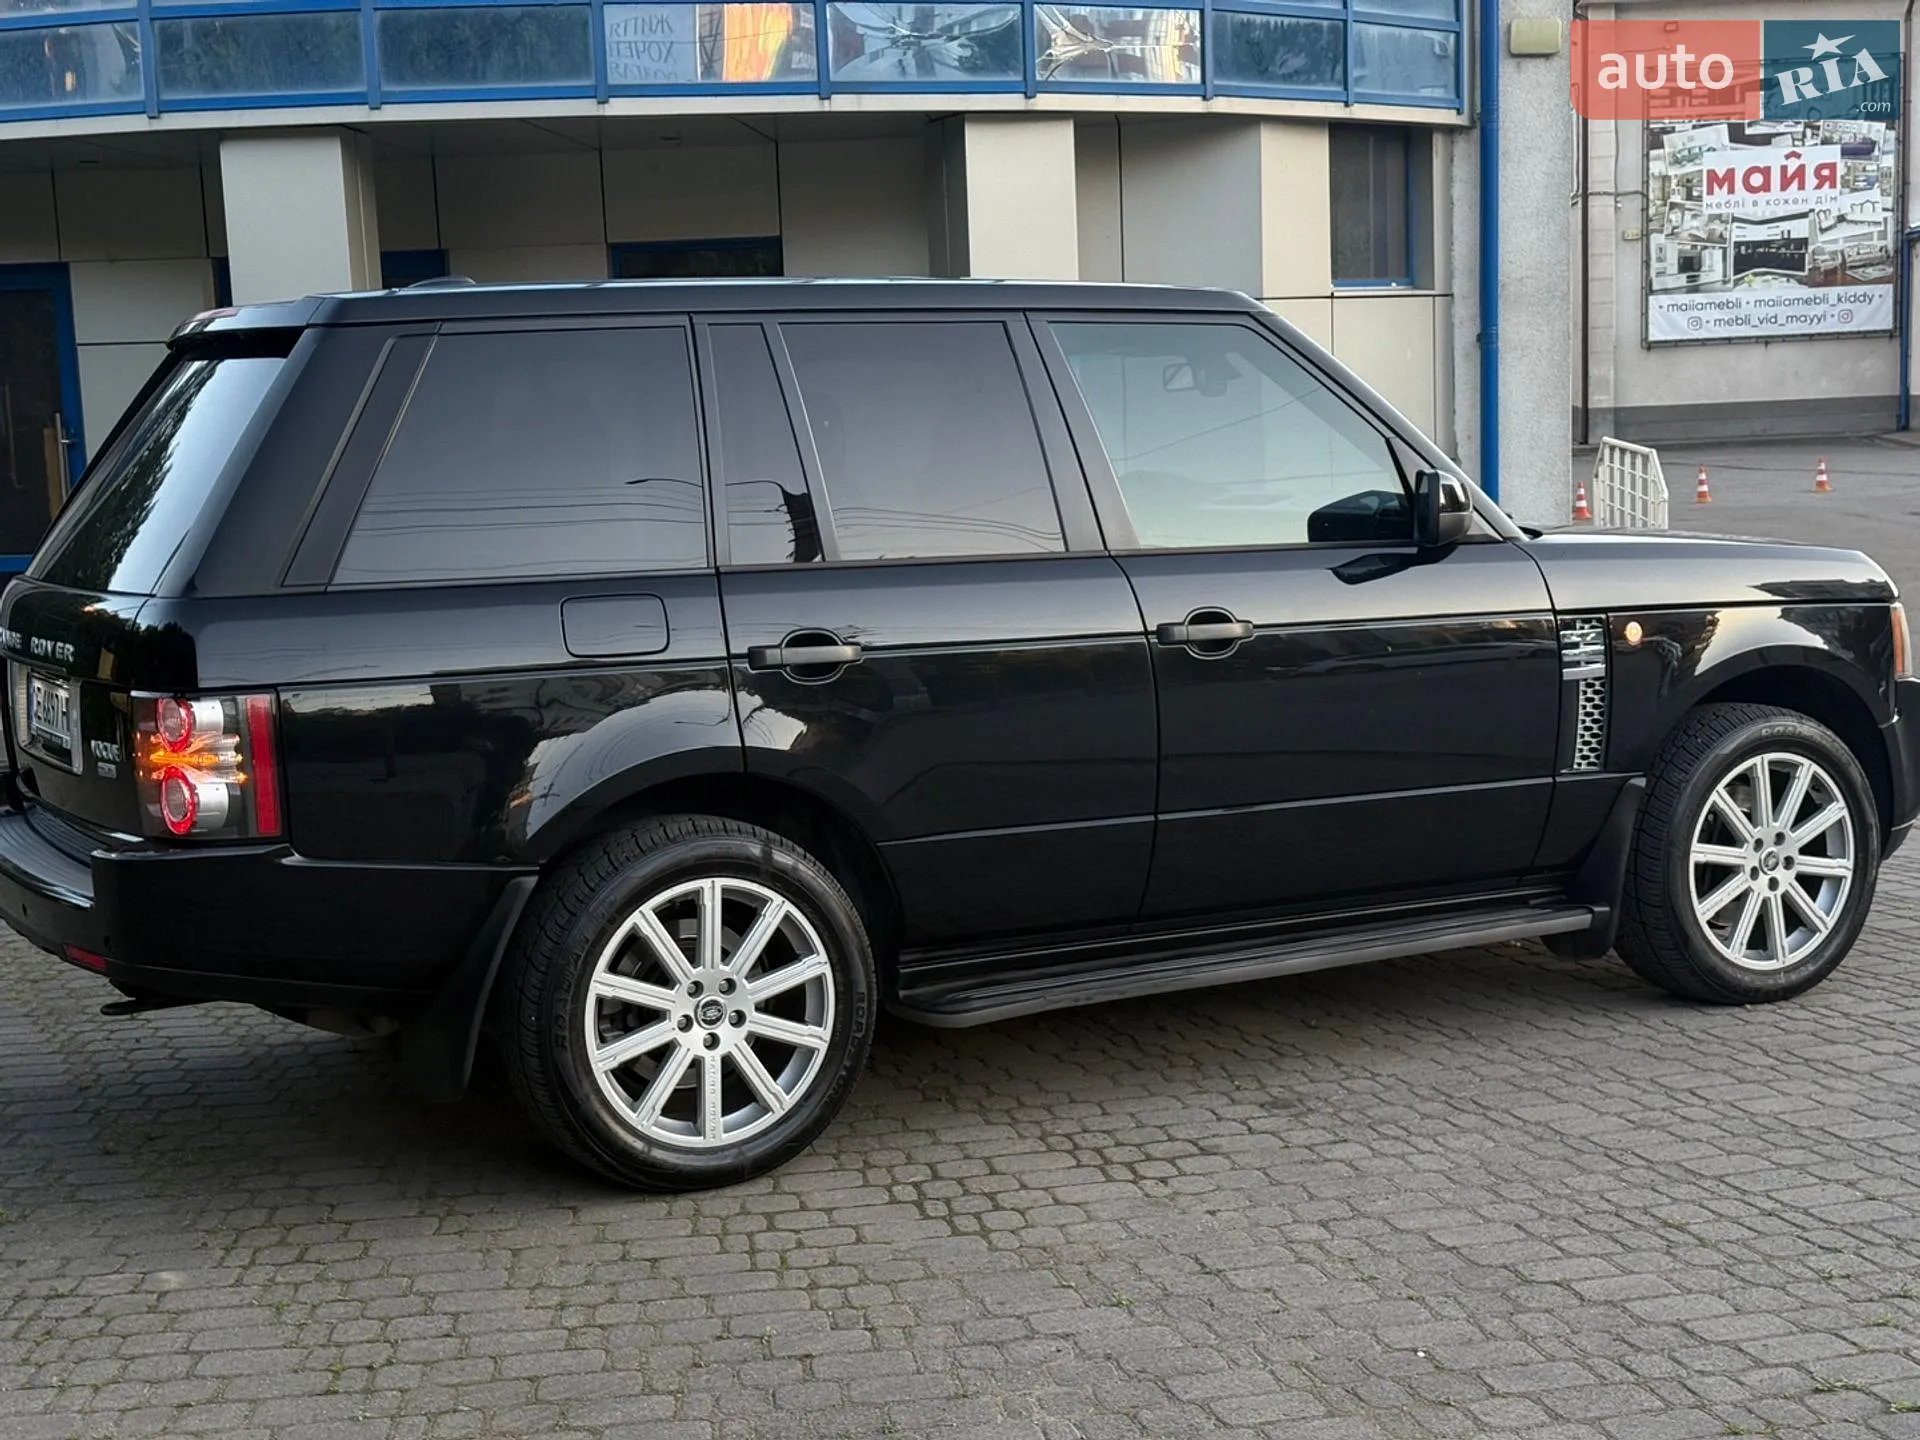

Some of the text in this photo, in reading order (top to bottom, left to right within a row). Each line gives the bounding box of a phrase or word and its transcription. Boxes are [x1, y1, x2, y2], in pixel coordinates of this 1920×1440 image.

[1706, 150, 1838, 196] майя
[1705, 195, 1838, 210] меблі в кожен дім
[1667, 291, 1875, 313] maiiamebli maiiamebli_kiddy
[30, 635, 75, 663] ROVER
